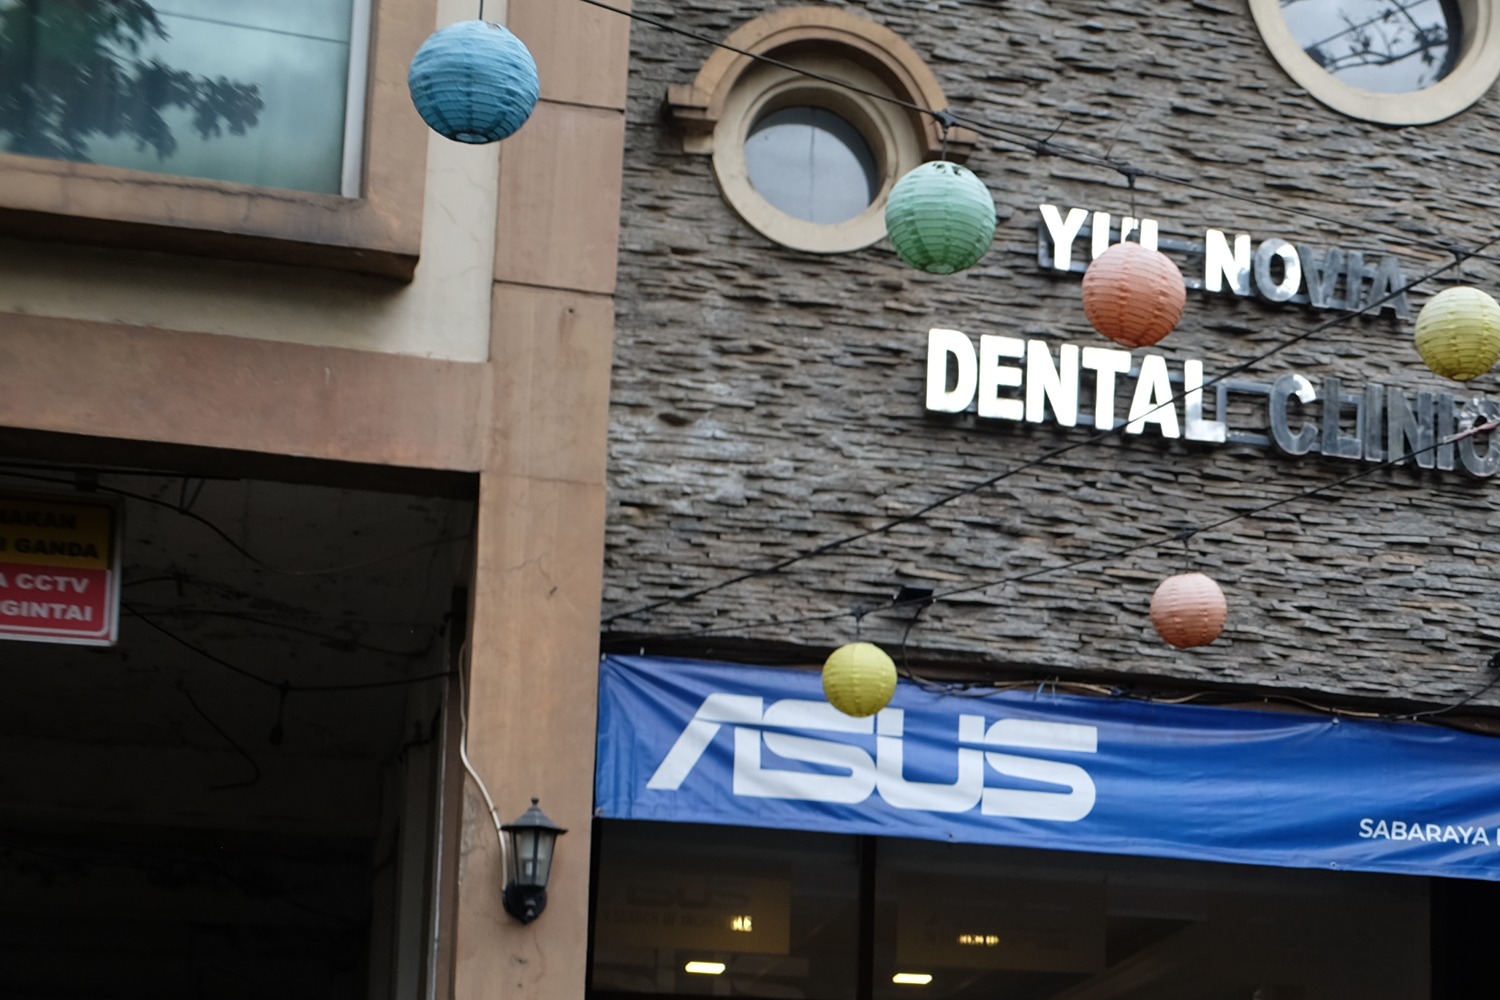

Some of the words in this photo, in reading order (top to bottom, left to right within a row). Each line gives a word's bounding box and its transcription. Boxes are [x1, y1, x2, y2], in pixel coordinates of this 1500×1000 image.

[1205, 228, 1410, 320] NOVIA
[926, 328, 1226, 443] DENTAL
[14, 537, 98, 558] GANDA
[14, 572, 90, 593] CCTV
[646, 692, 1098, 823] ASUS
[1359, 818, 1490, 846] SABARAYA
